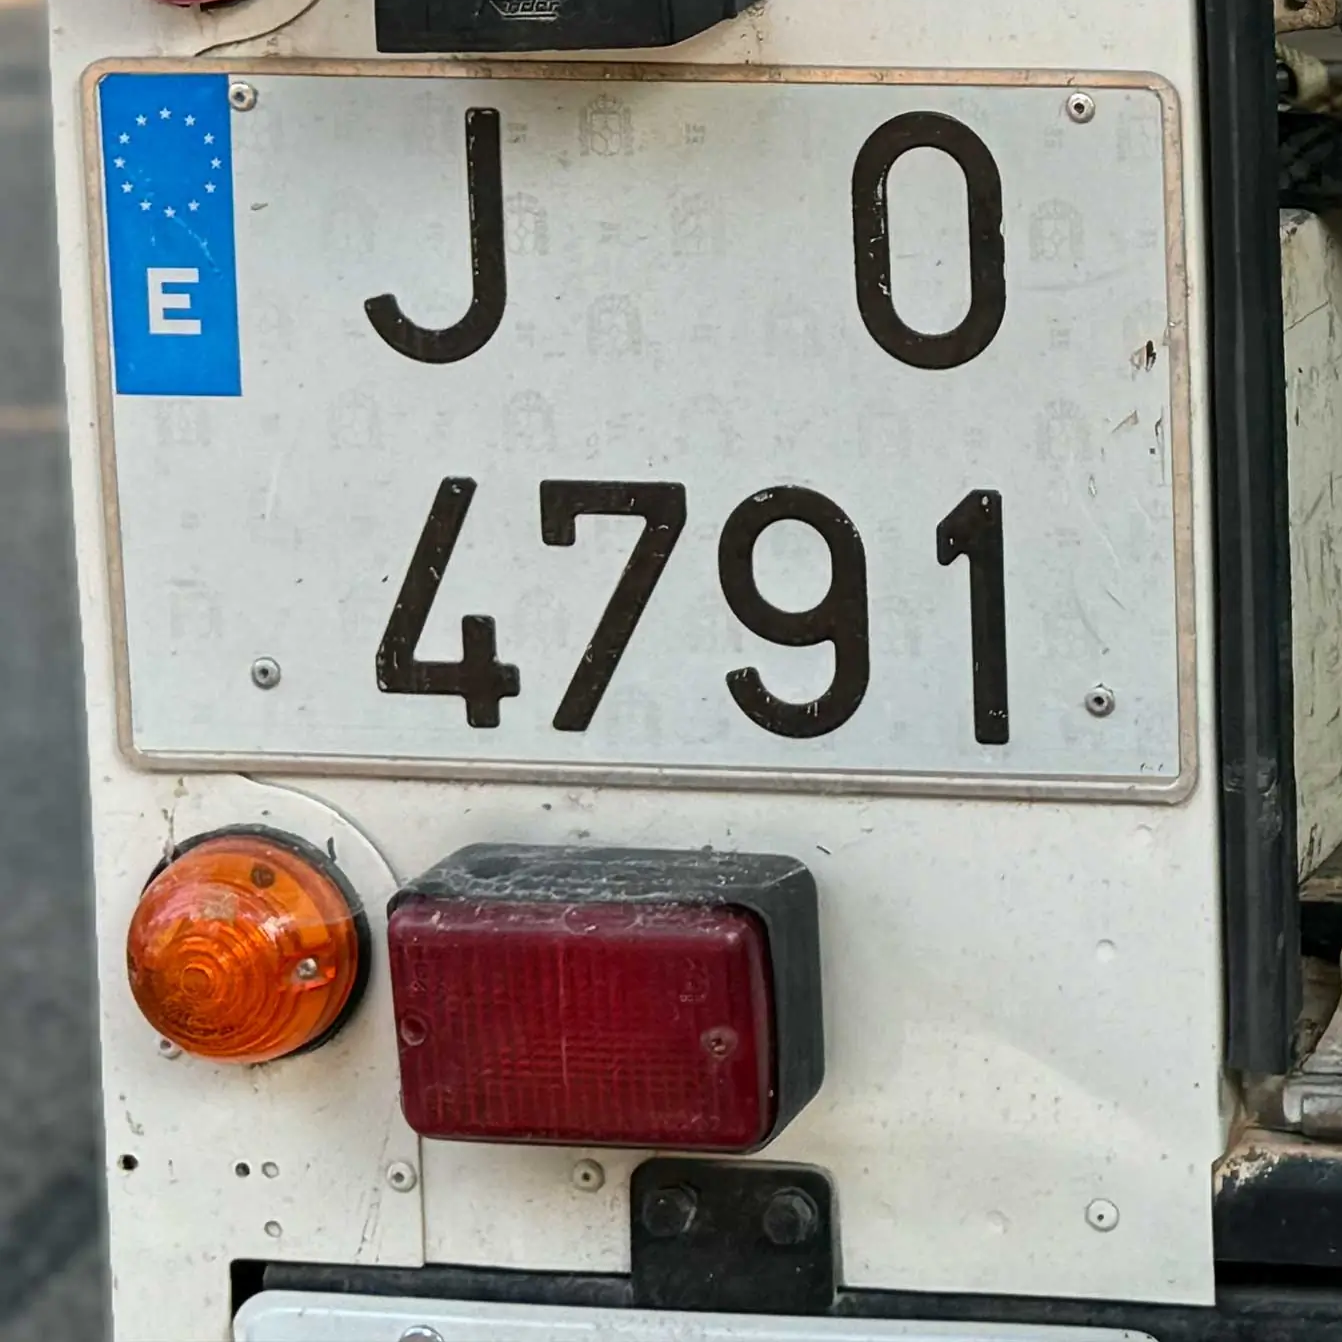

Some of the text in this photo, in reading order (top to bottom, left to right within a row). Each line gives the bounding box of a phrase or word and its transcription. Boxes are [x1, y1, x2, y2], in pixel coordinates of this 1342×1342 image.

[147, 267, 201, 335] E
[364, 106, 507, 365] J
[375, 476, 1010, 746] 4791
